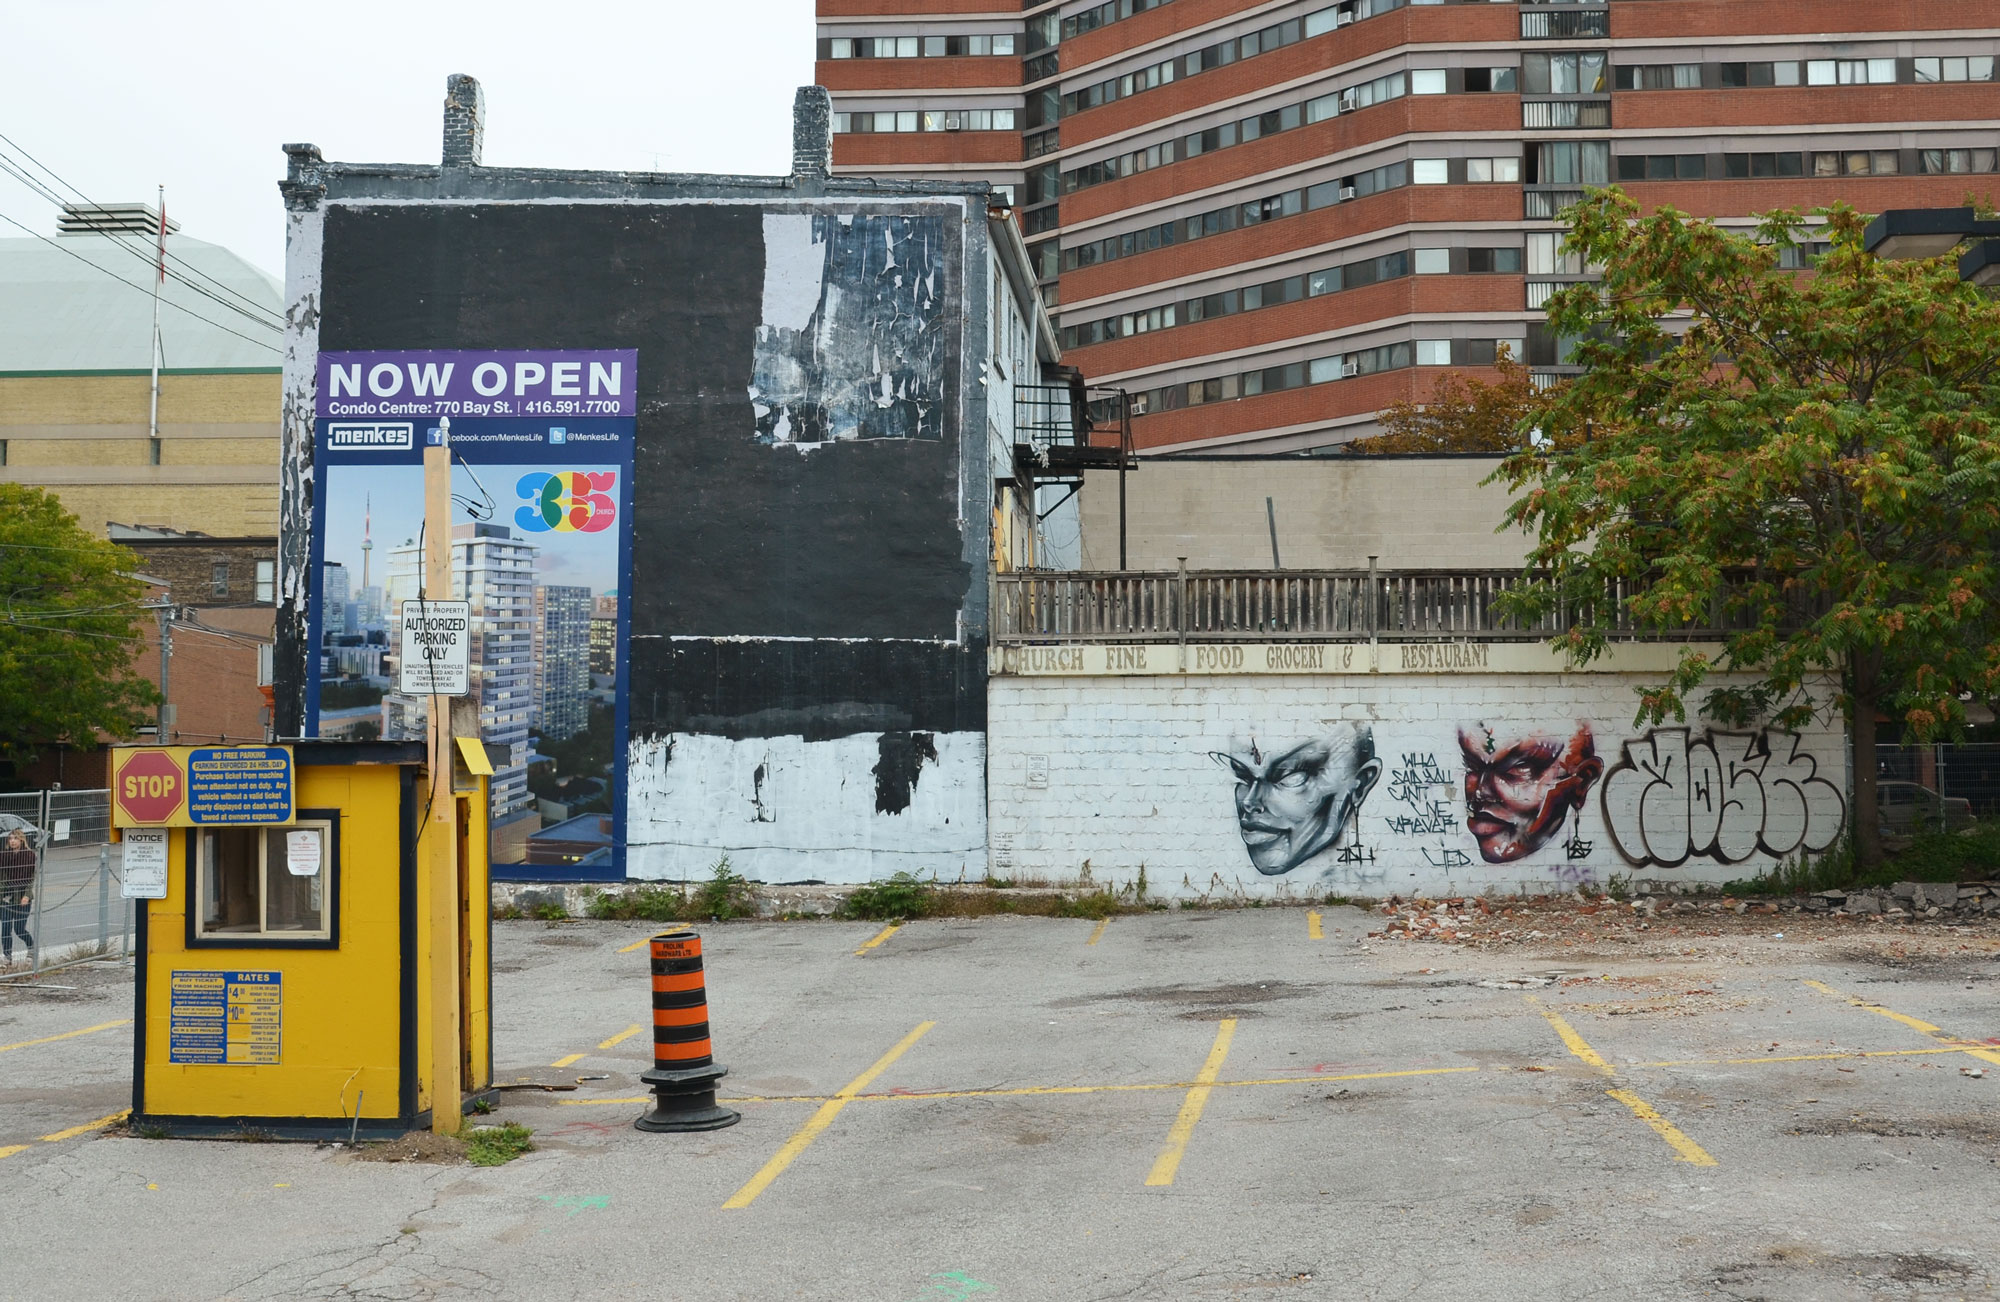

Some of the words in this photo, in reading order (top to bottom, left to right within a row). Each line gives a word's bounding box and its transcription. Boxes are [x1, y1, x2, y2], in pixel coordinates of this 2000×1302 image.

[329, 362, 454, 397] NOW
[472, 362, 621, 396] OPEN
[329, 402, 377, 414] Condo
[380, 402, 432, 414] Centre:
[434, 401, 460, 414] 770
[463, 401, 490, 416] Bay
[493, 401, 513, 414] St.
[526, 400, 620, 414] 416.591.7700
[335, 428, 408, 444] menkes
[452, 433, 543, 442] cebook.com/MenkesLife
[566, 432, 619, 442] @MenkesLife
[514, 471, 616, 532] 365
[405, 618, 466, 630] AUTHORIZED
[414, 632, 456, 645] PARKING
[422, 647, 448, 660] ONLY
[1004, 647, 1084, 672] CHURCH
[1105, 646, 1147, 670] FINE
[1196, 646, 1244, 670] FOOD
[1266, 645, 1325, 669] GROCERY
[1401, 644, 1490, 668] RESTAURANT
[1402, 752, 1438, 768] WHO
[1392, 768, 1422, 785] SAID
[125, 775, 175, 798] STOP
